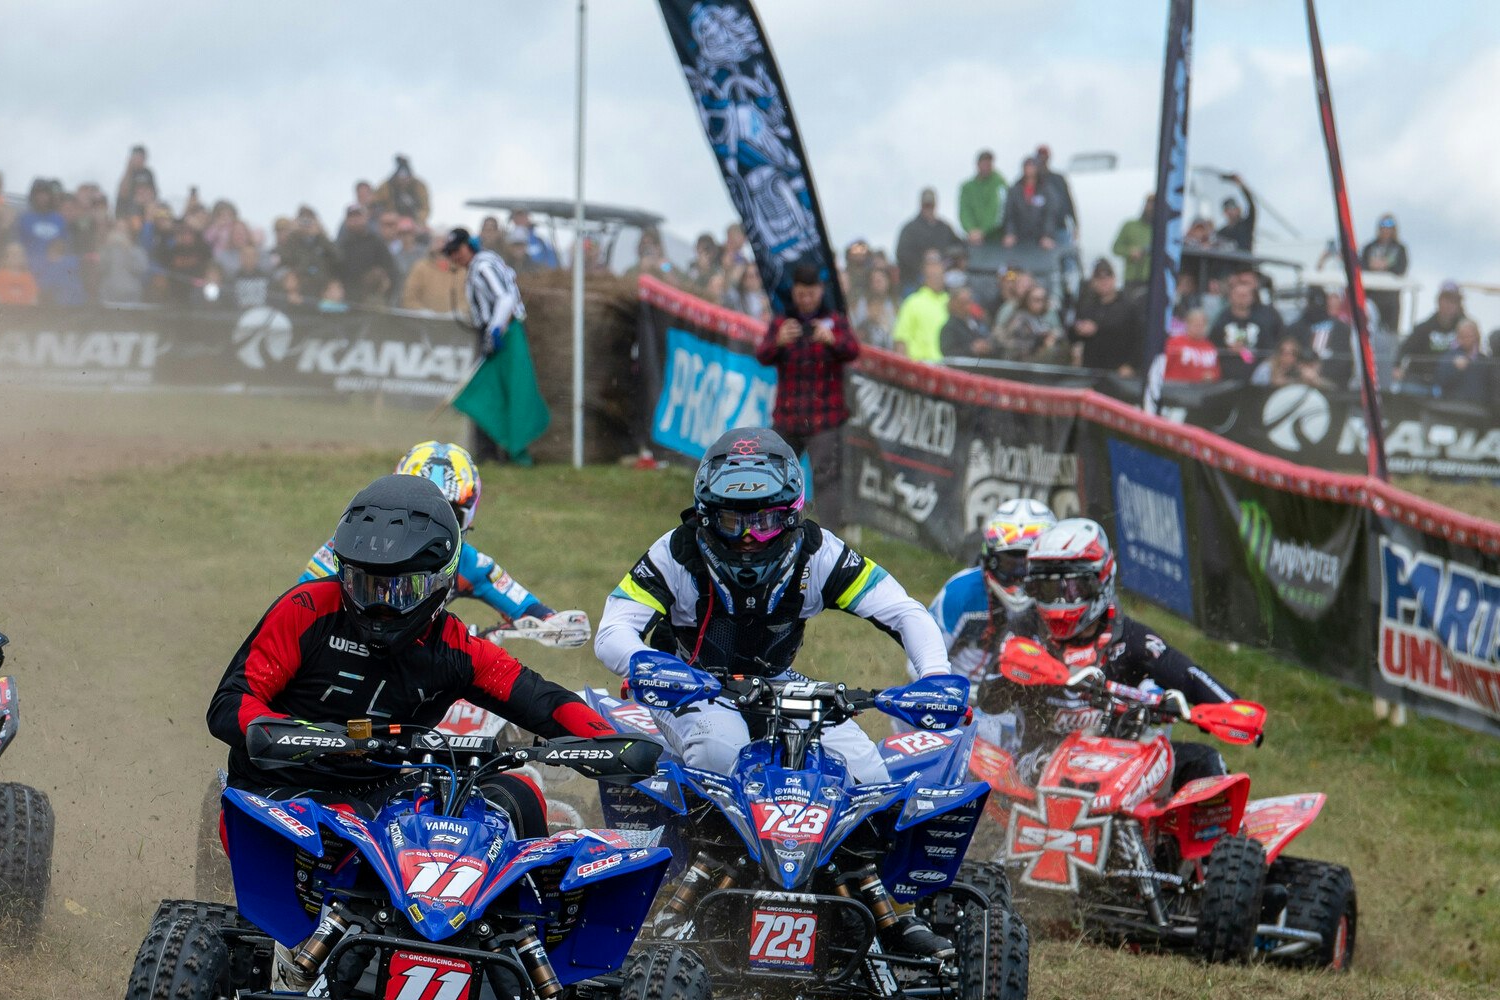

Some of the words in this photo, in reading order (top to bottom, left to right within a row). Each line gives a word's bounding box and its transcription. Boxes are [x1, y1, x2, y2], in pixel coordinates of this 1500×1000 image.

[724, 482, 767, 494] FLY
[329, 635, 371, 658] WPS
[638, 680, 670, 689] FOWLER
[926, 703, 958, 712] FOWLER
[277, 735, 347, 748] ACERBIS
[887, 731, 945, 754] 723
[546, 750, 614, 760] ACERBIS
[782, 787, 811, 798] YAMAHA
[916, 787, 965, 796] GBC
[760, 804, 828, 835] 723
[389, 821, 404, 848] ACTION
[426, 821, 469, 836] YAMAHA
[432, 834, 462, 845] SSI
[487, 835, 504, 863] ACTION
[629, 849, 649, 861] SSI
[576, 853, 623, 876] GBC
[406, 861, 484, 899] 11
[749, 914, 816, 959] 723
